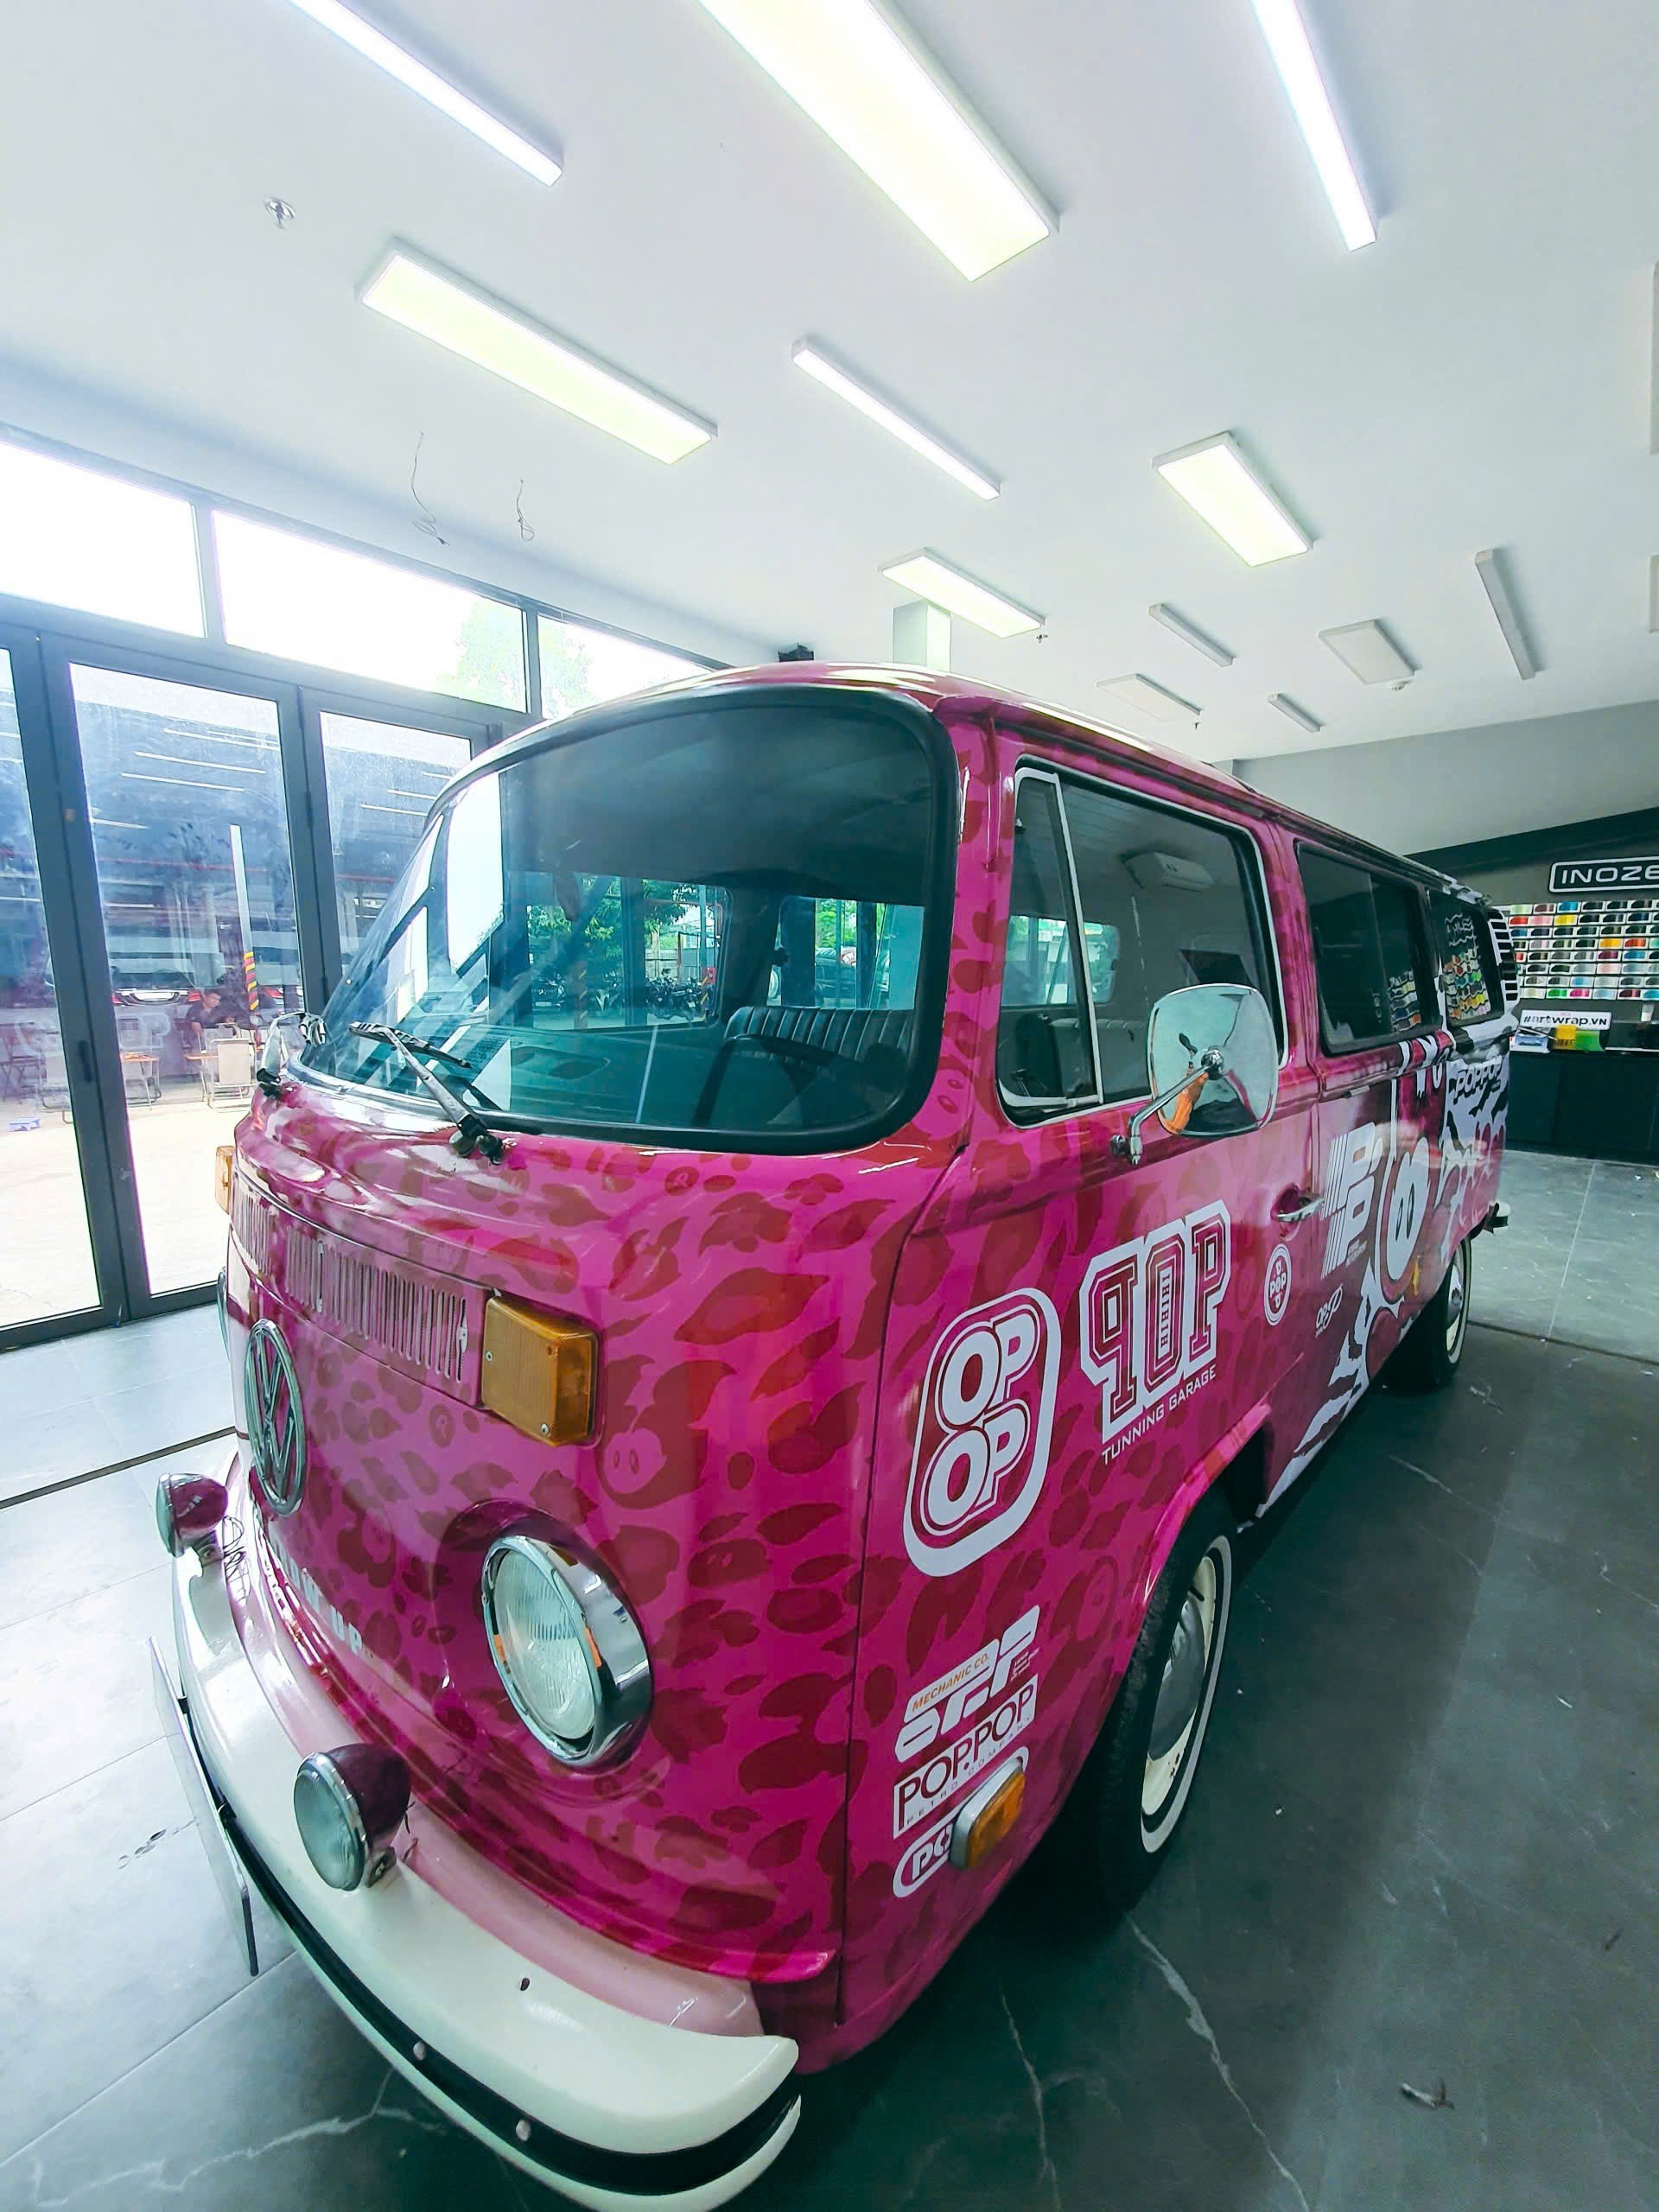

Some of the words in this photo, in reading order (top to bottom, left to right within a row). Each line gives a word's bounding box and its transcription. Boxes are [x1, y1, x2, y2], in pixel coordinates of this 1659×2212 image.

[1523, 1015, 1607, 1026] #artwrap.VN
[1102, 1403, 1165, 1465] TUNNING
[1168, 1364, 1217, 1411] GARAGE
[912, 1664, 971, 1713] MECHANIC
[974, 1652, 990, 1670] CO.
